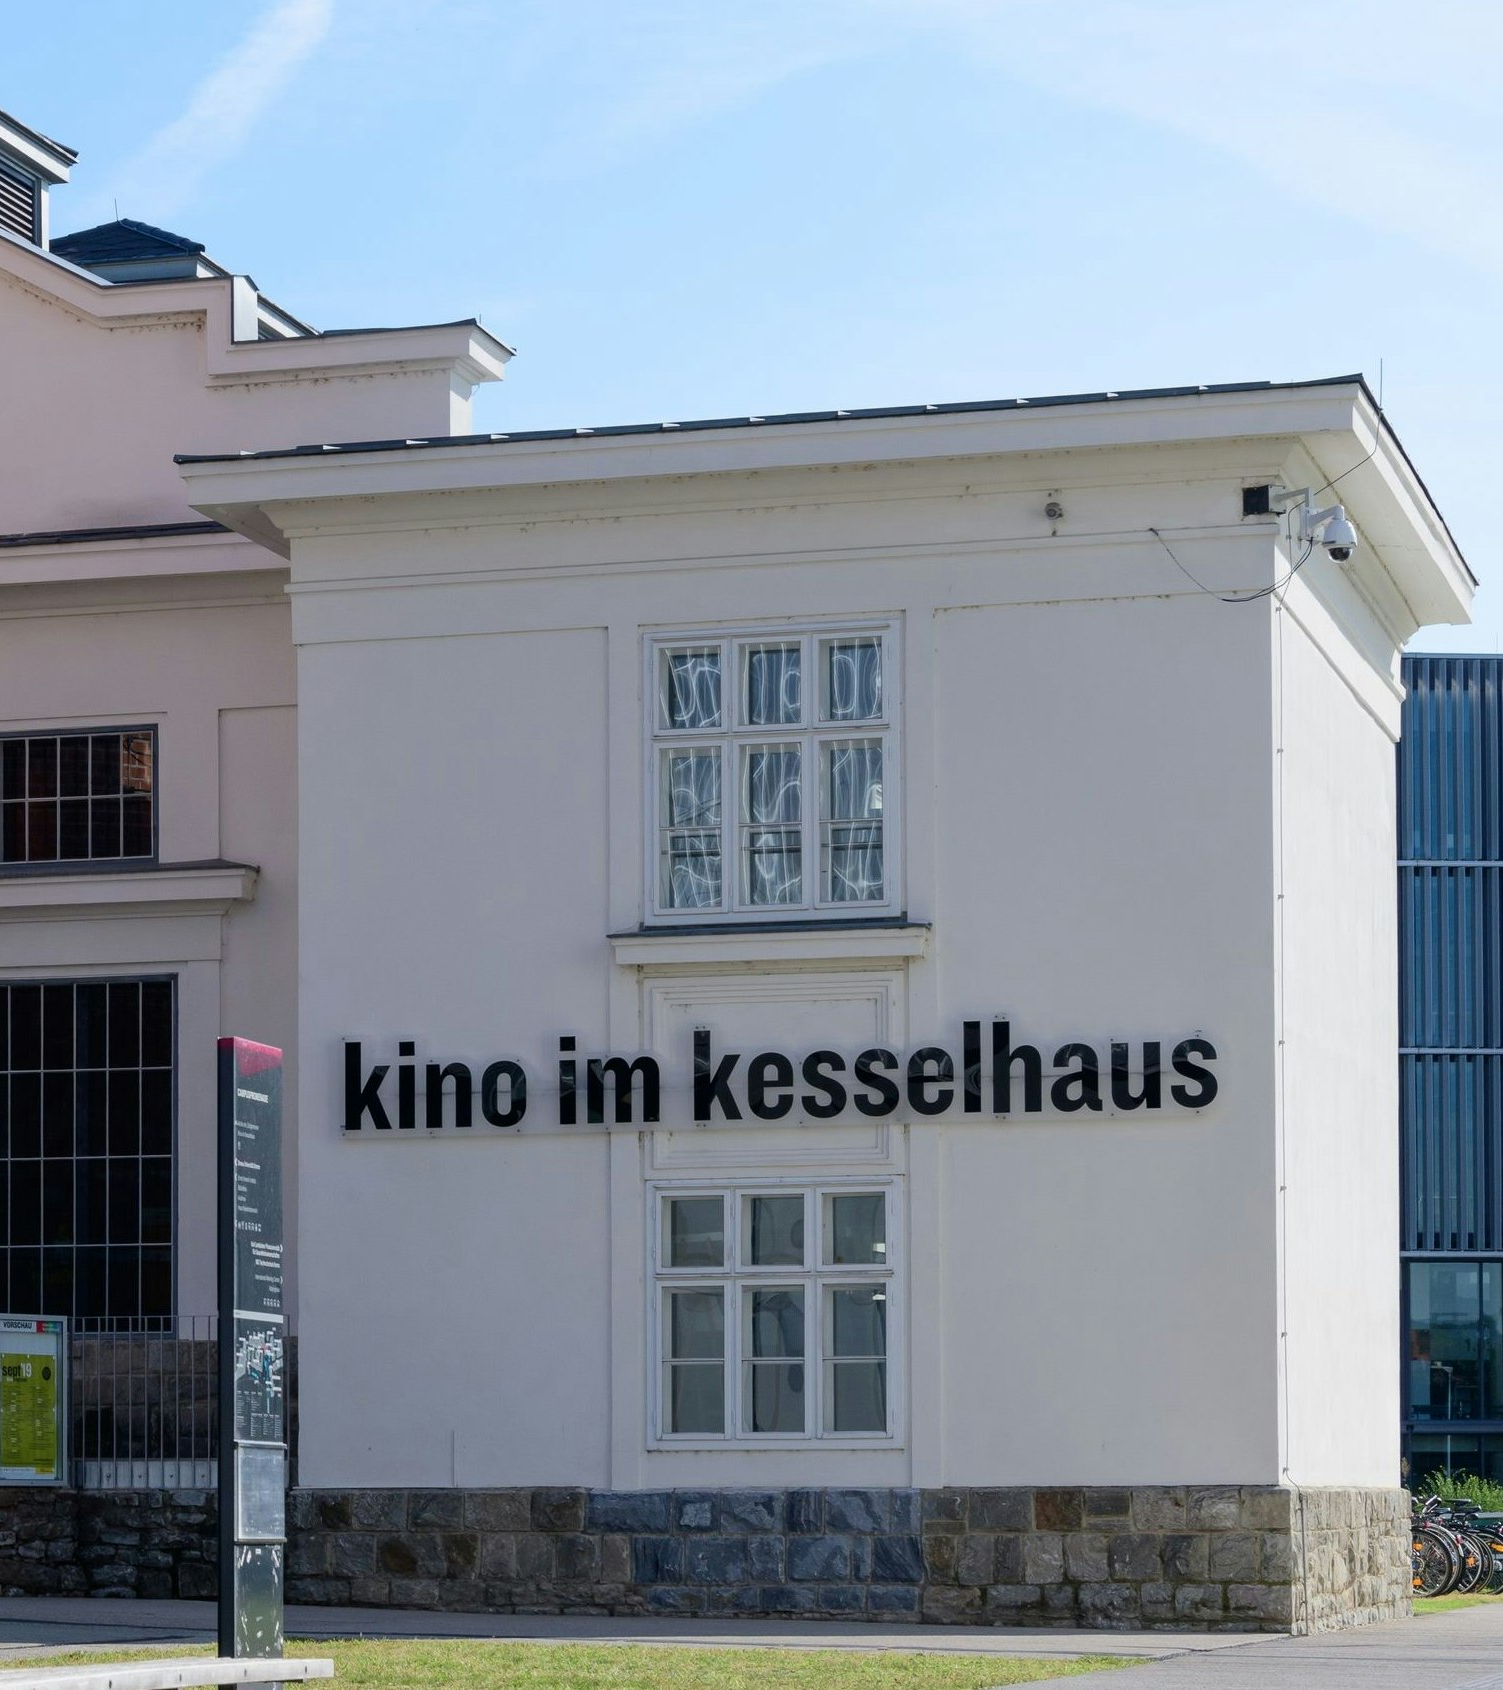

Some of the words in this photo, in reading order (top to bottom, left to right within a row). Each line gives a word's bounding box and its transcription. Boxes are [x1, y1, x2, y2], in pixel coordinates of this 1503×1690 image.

[345, 1042, 528, 1130] kino
[560, 1037, 660, 1123] im
[694, 1019, 1218, 1120] kesselhaus
[3, 1321, 32, 1329] VORSCHAU
